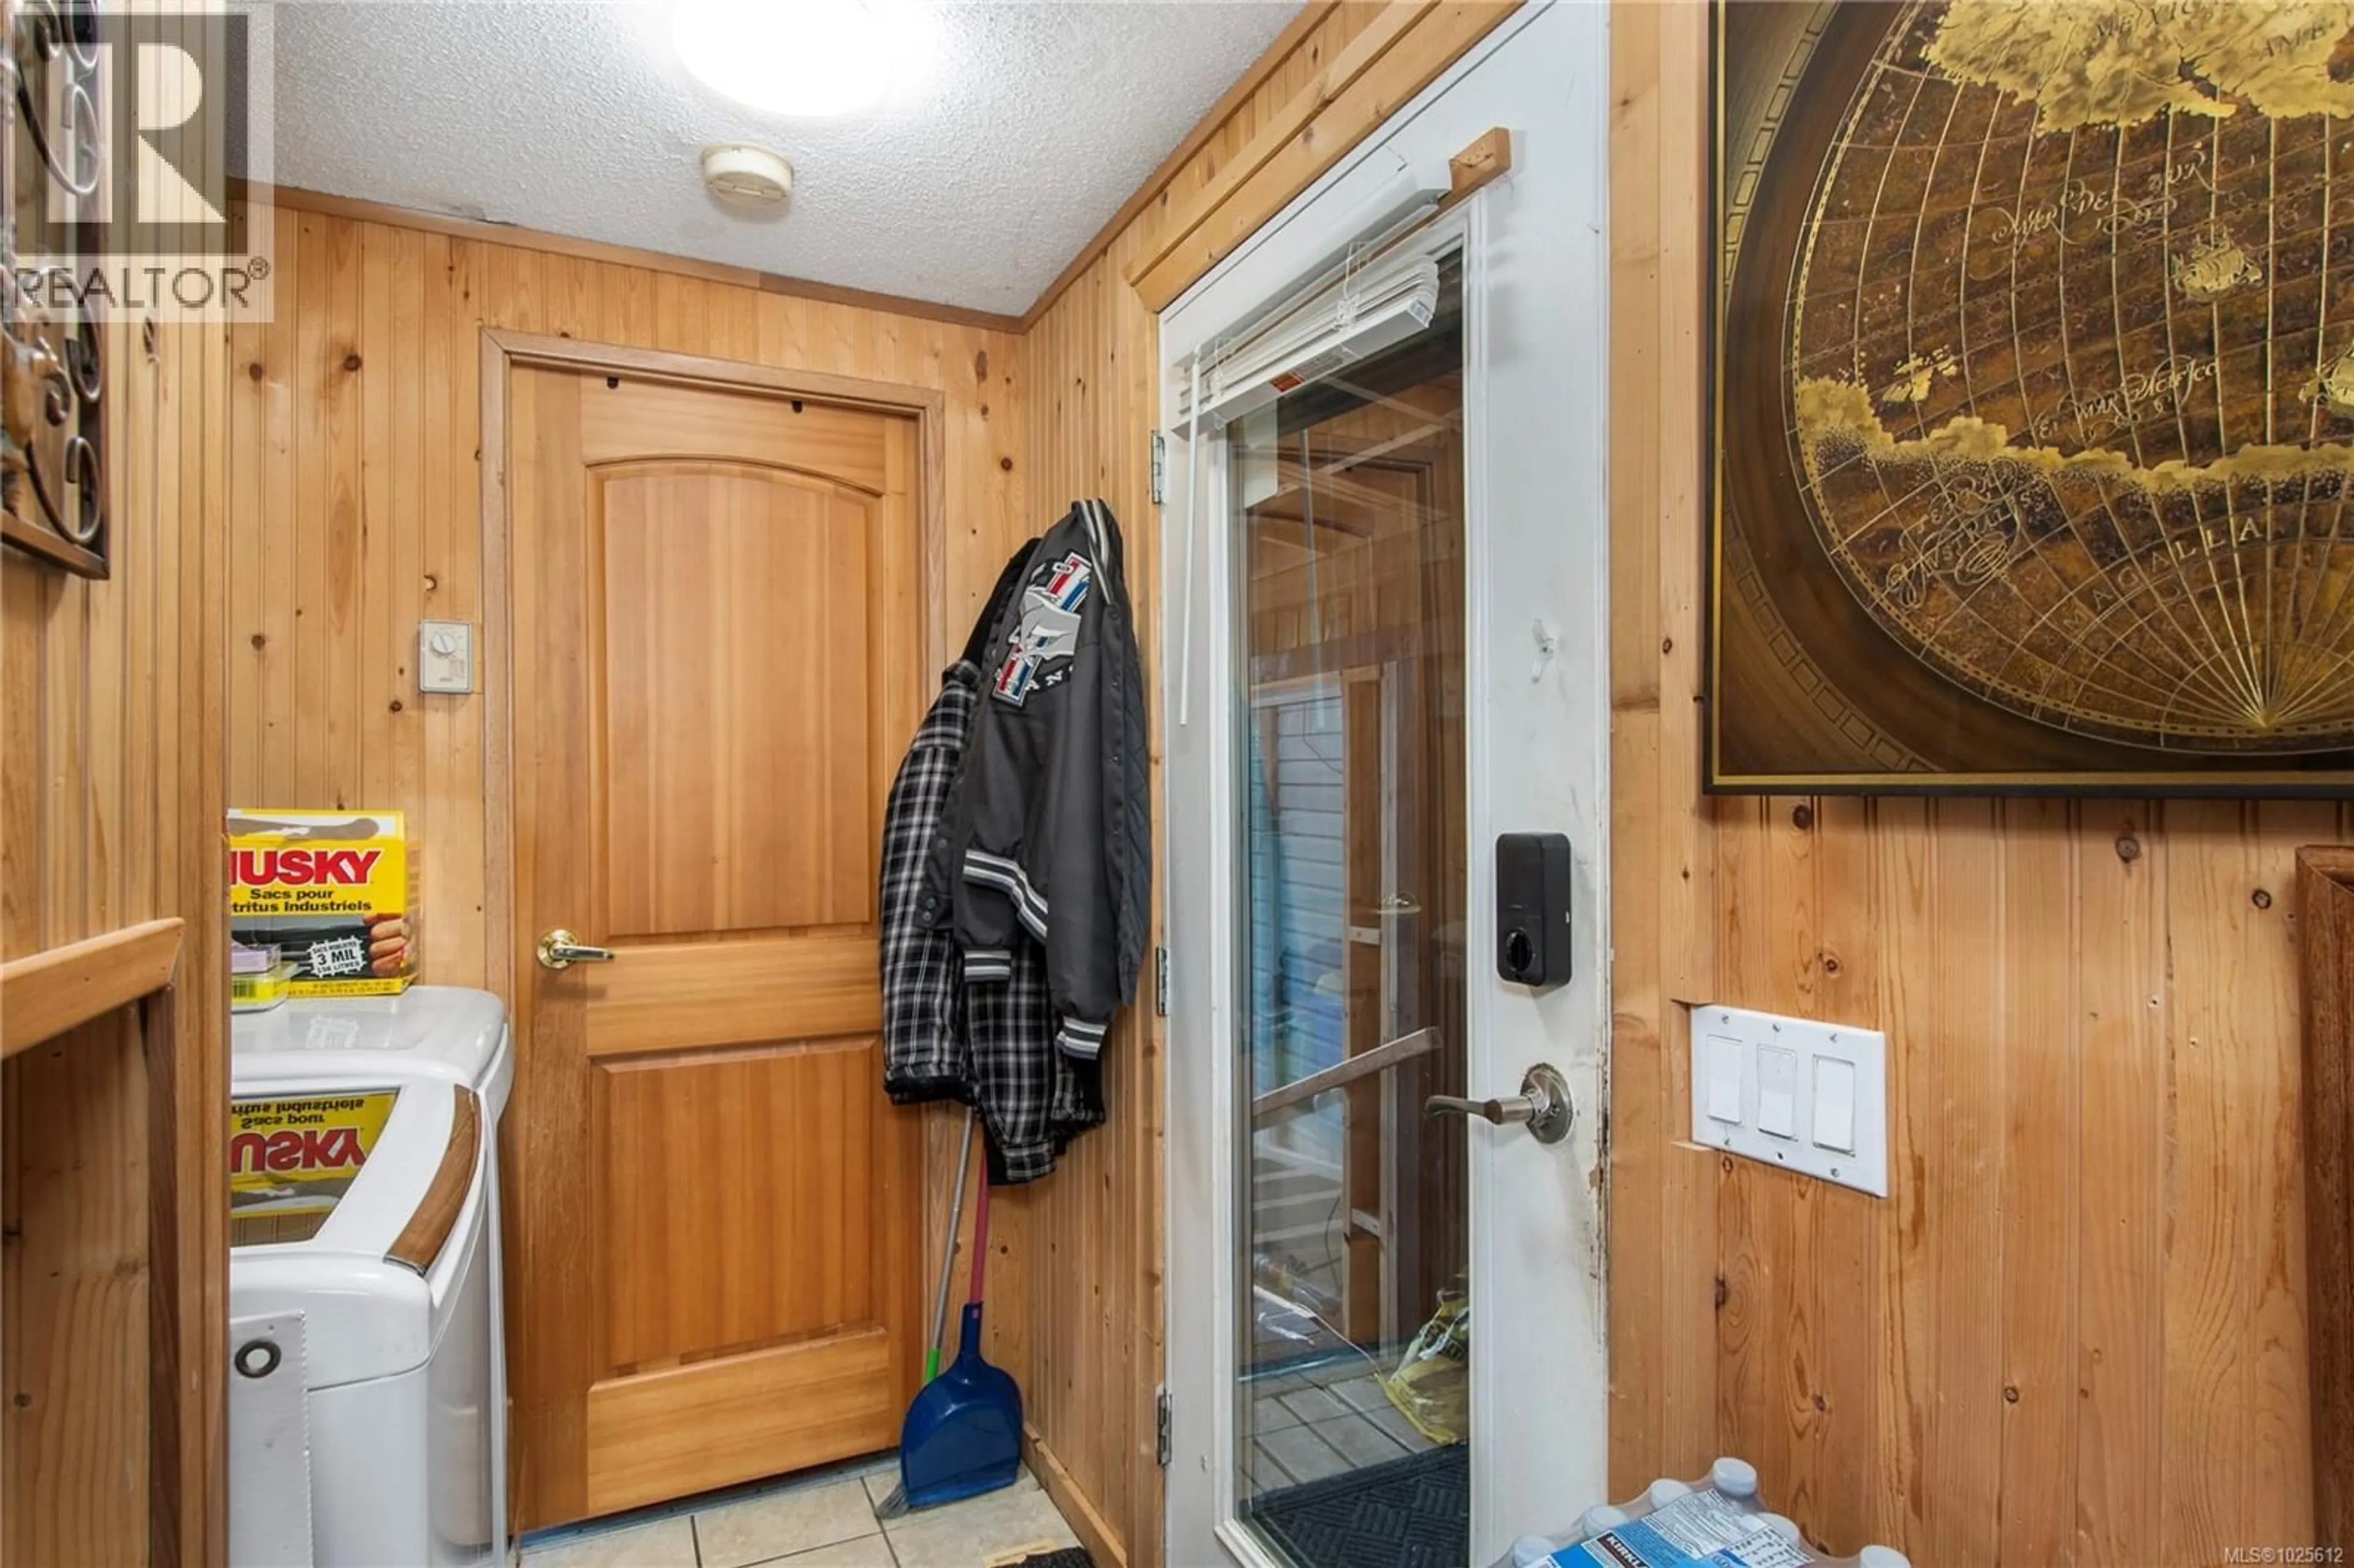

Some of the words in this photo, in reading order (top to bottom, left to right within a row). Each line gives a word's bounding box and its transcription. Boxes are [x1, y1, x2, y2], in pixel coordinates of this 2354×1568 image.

[230, 850, 381, 885] USKY
[250, 888, 292, 900] Sacs
[296, 890, 334, 903] pour
[232, 902, 279, 913] tritus
[284, 901, 372, 912] Industriels
[318, 953, 327, 965] 3
[331, 948, 357, 963] MIL
